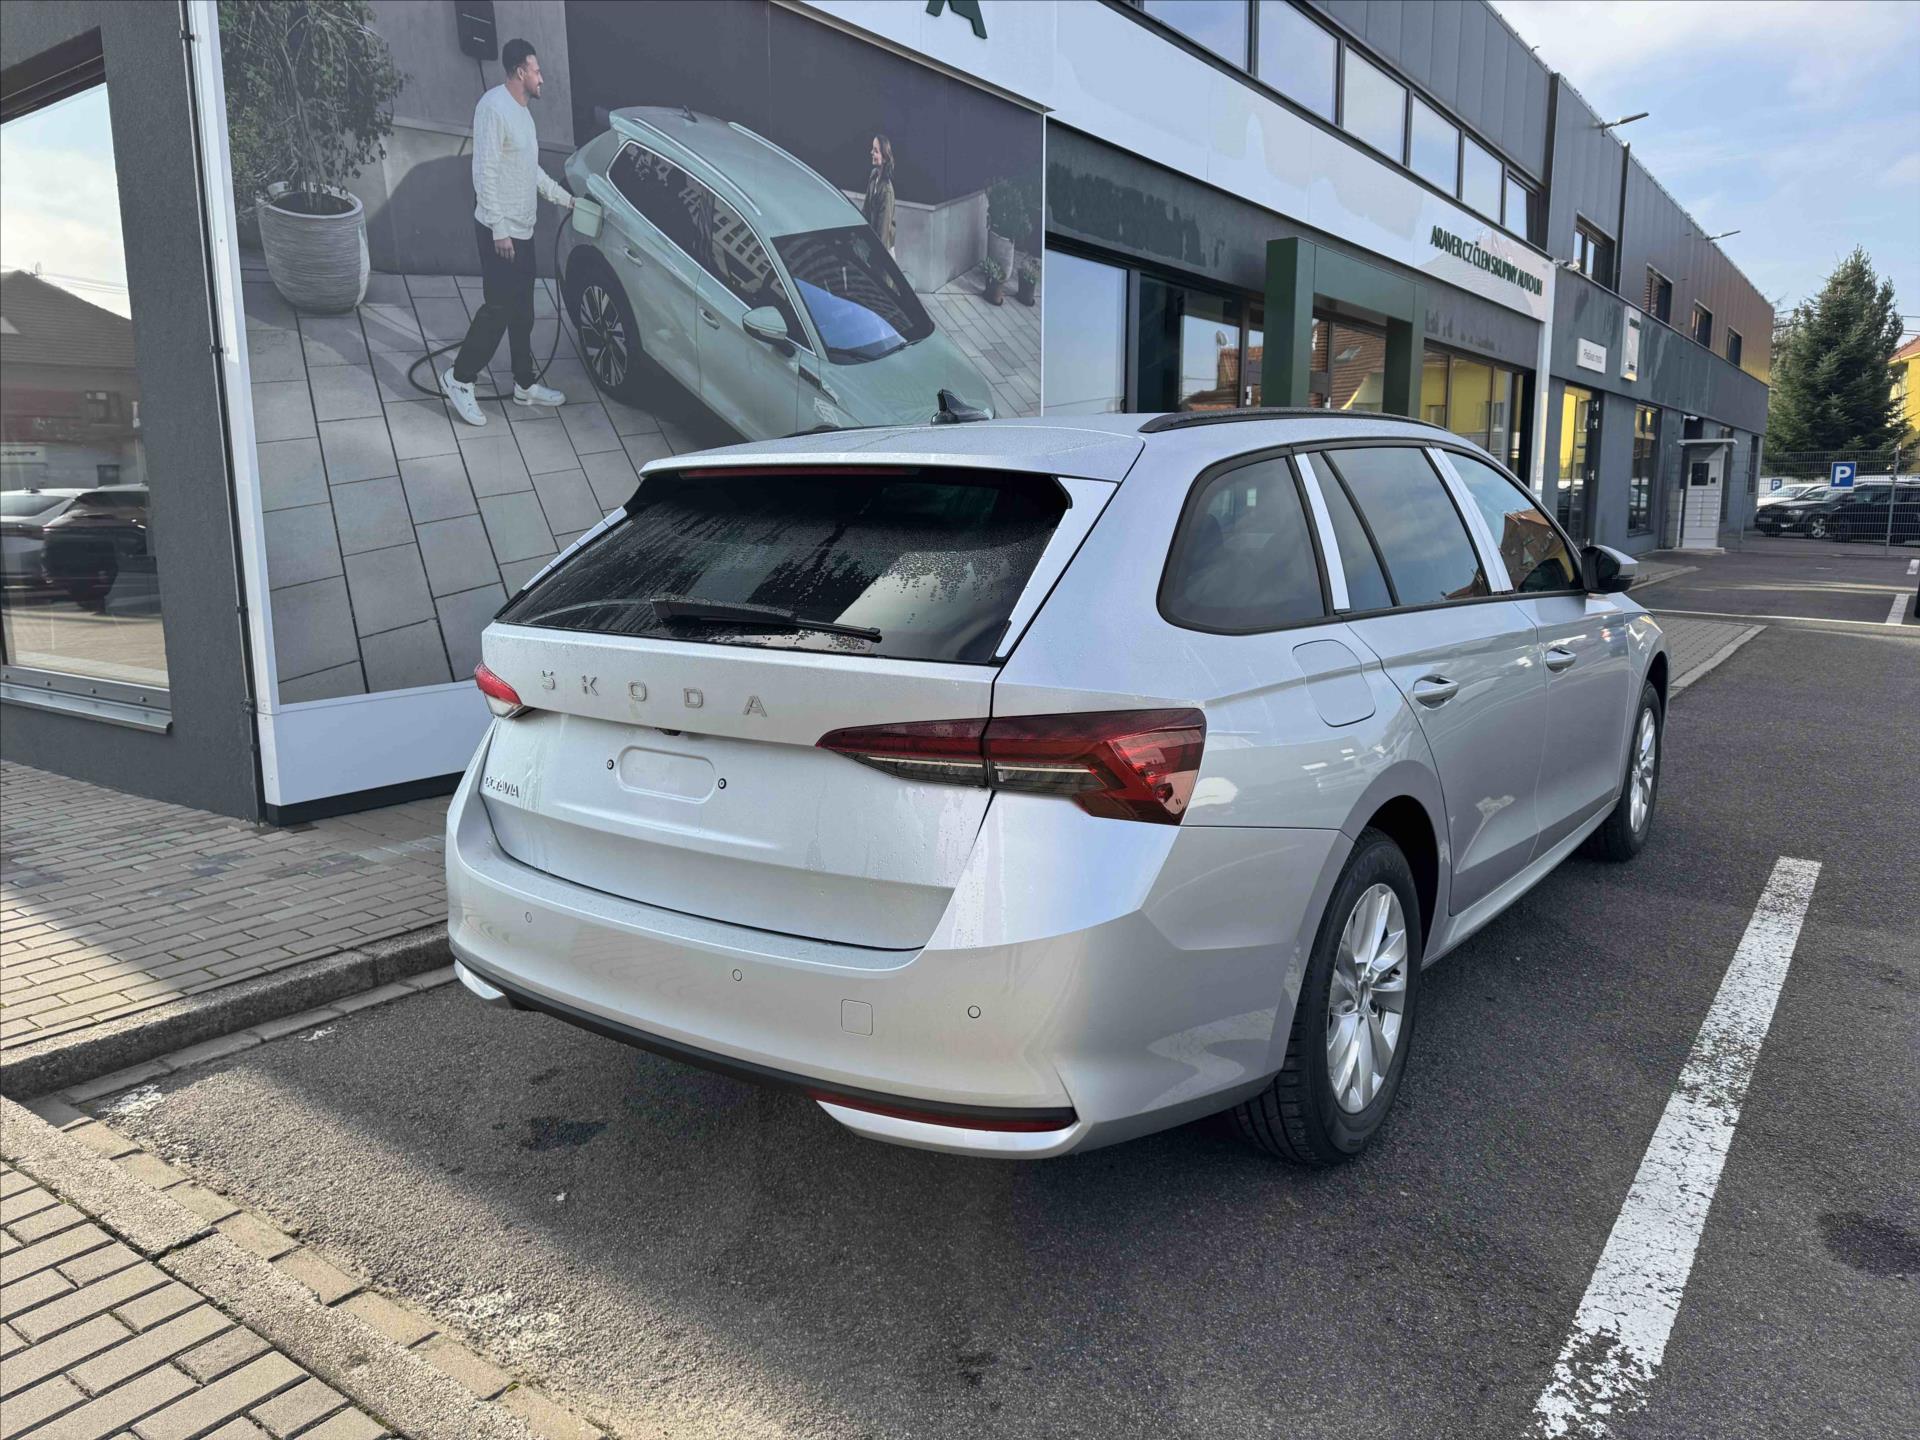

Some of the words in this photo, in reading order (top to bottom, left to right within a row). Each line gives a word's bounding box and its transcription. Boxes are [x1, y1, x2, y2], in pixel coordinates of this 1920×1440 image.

[1430, 225, 1462, 258] ARAVER
[1462, 241, 1473, 263] CZ
[1473, 241, 1491, 272] ČLEN
[1491, 255, 1518, 284] SKUPINY
[1835, 466, 1851, 484] P
[541, 669, 768, 718] ŠKODA
[485, 776, 519, 798] OCTAVIA
